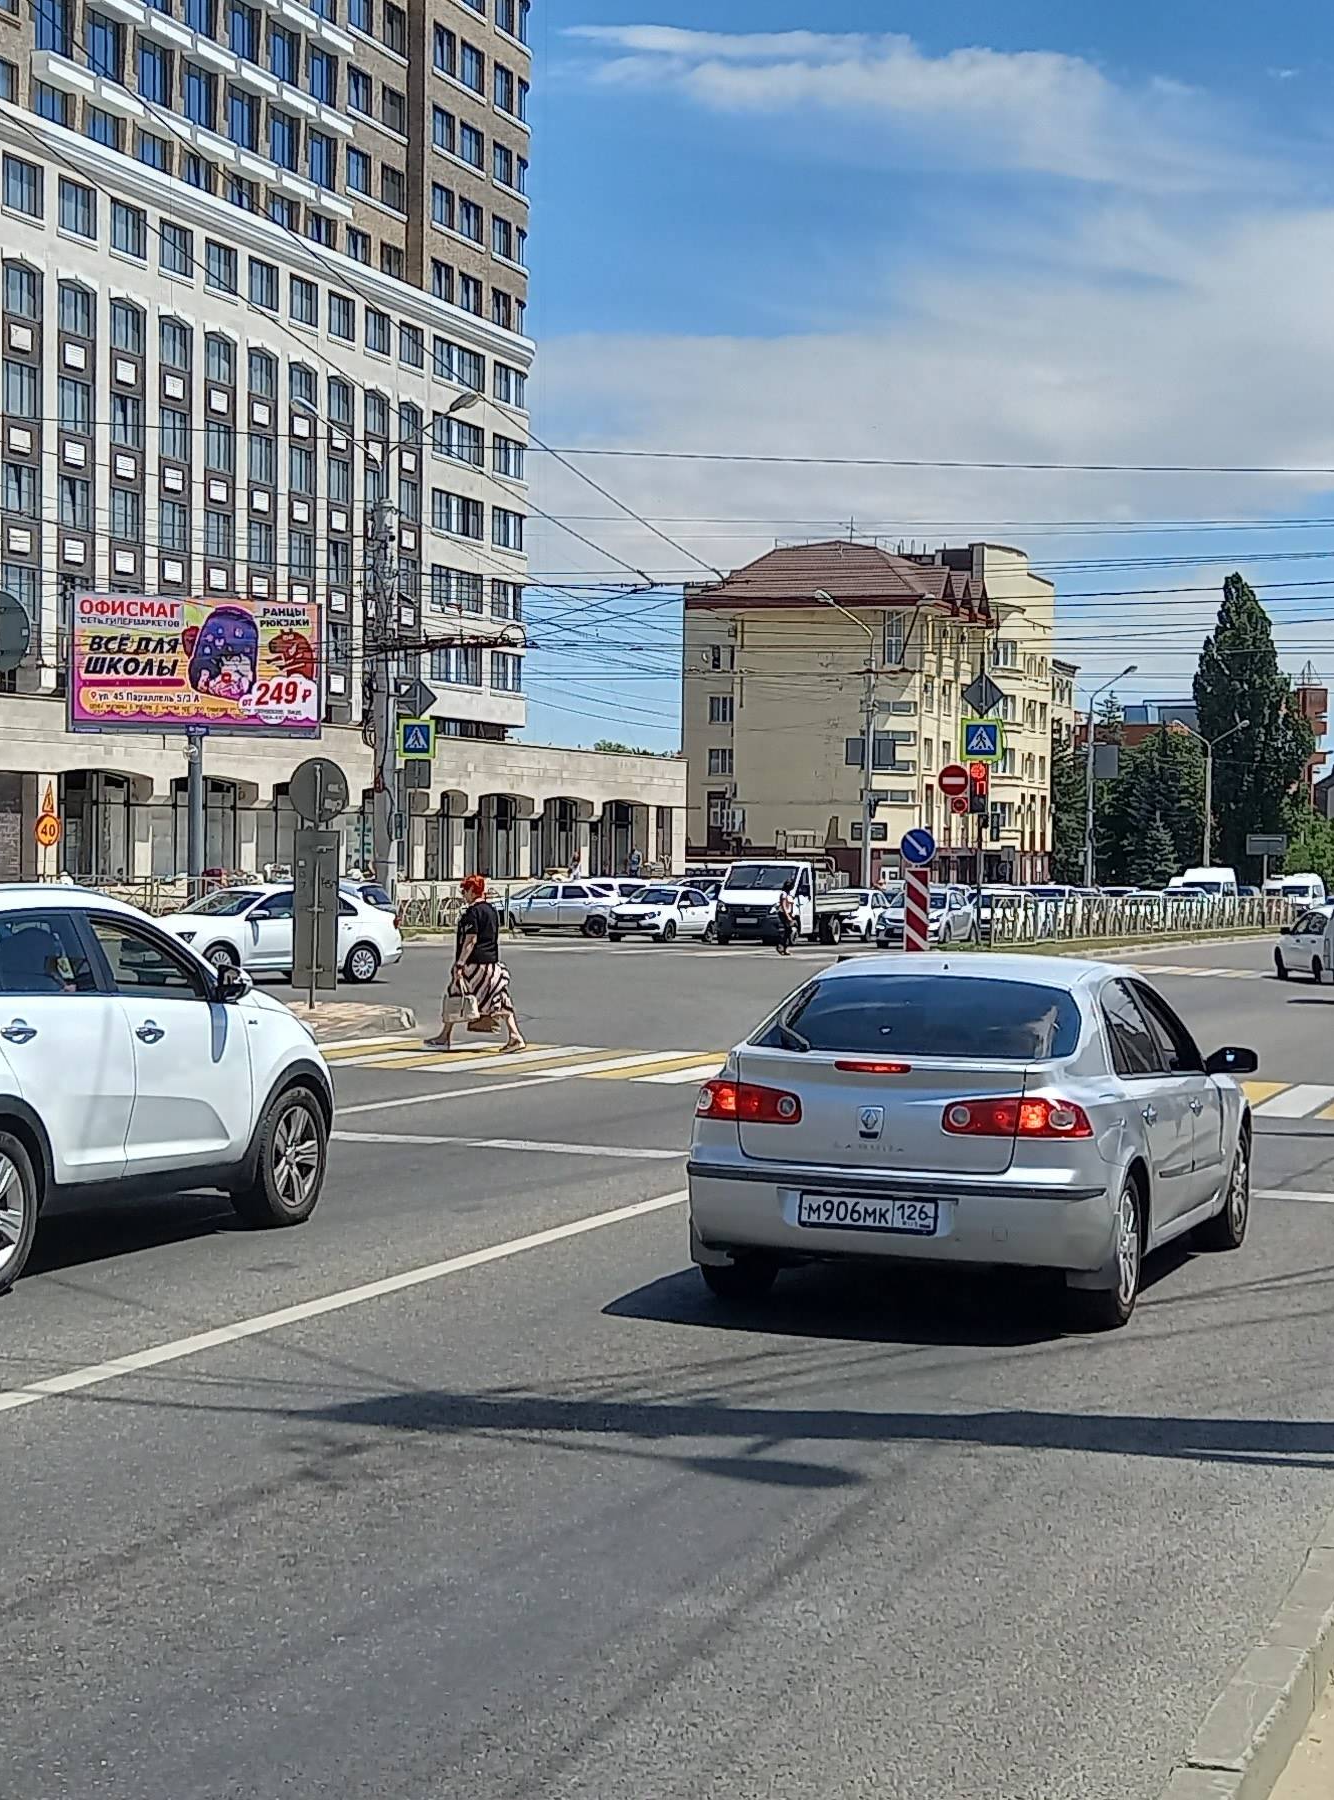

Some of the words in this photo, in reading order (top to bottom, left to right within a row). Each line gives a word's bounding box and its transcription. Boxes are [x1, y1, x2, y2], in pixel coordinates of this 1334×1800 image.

[79, 599, 181, 618] ОФИСМАГ
[262, 607, 306, 618] РАНЦЫ
[259, 618, 310, 628] РЮКЗАКИ
[88, 633, 131, 652] ВСЁ
[136, 636, 180, 655] ДЛЯ
[84, 656, 179, 677] ШКОЛЫ
[113, 692, 124, 700] 45
[127, 692, 174, 703] Параллель
[41, 824, 55, 837] 40
[807, 1199, 890, 1225] М906МК
[896, 1203, 928, 1221] 126
